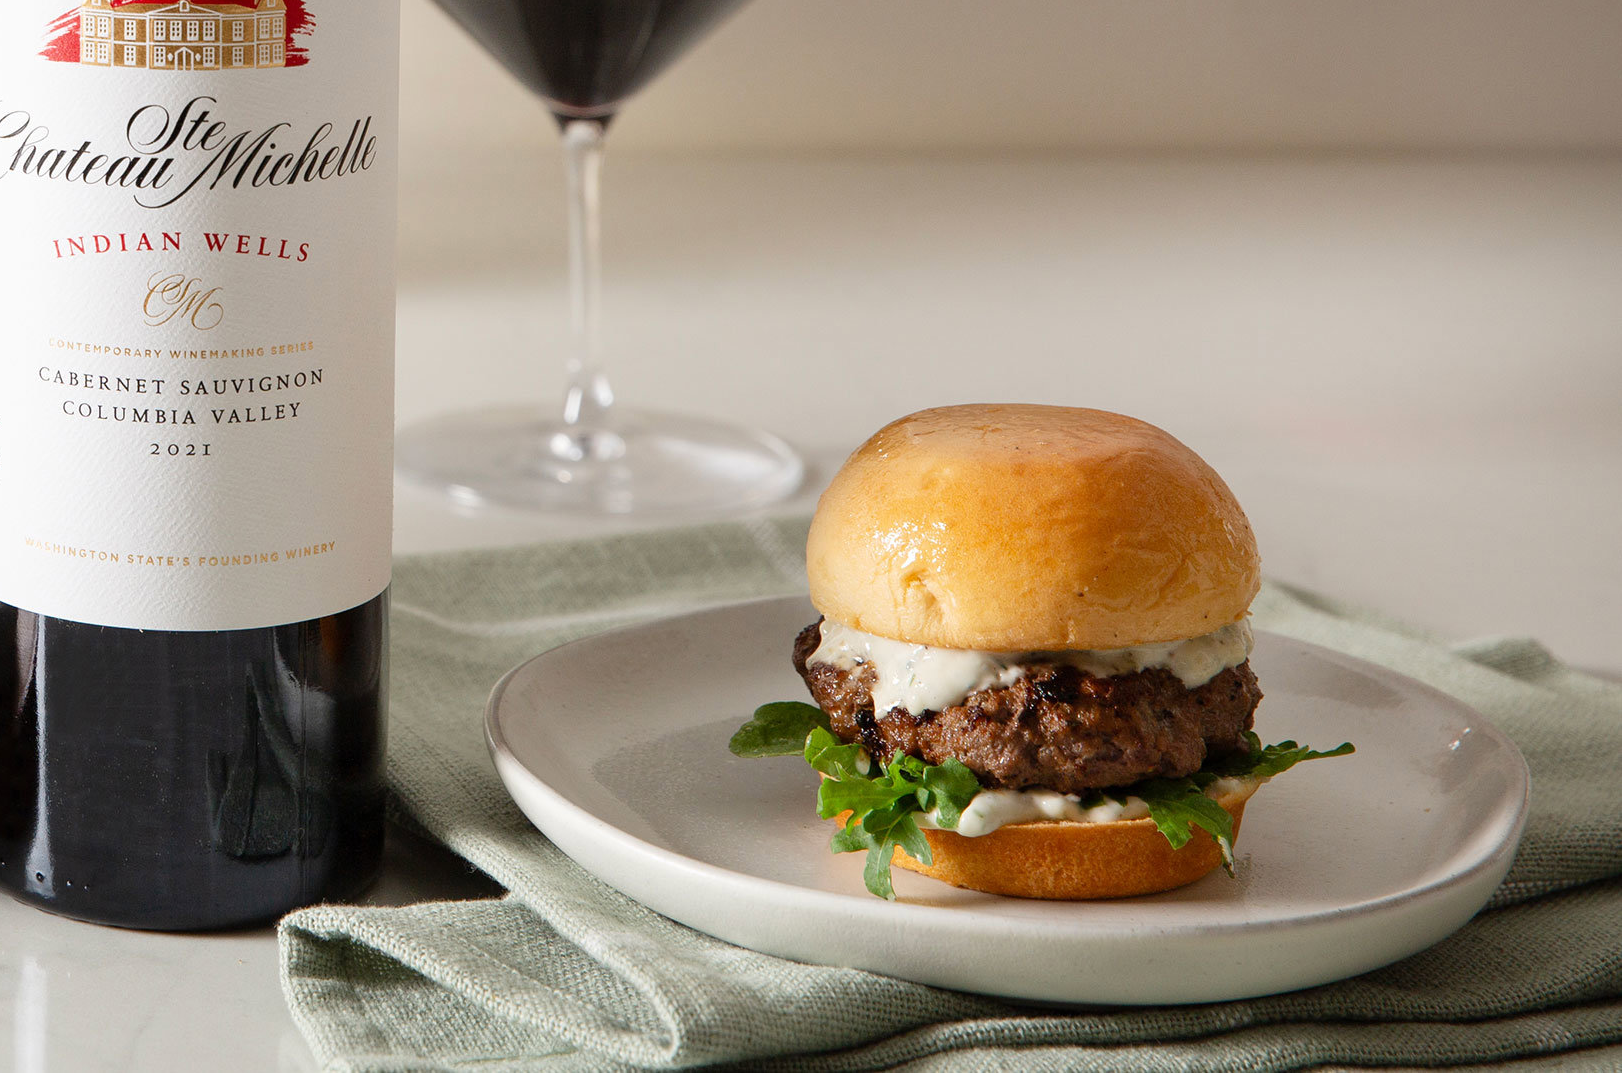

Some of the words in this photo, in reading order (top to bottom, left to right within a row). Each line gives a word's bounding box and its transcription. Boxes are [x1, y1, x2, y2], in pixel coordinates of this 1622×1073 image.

[125, 95, 227, 156] Ste
[133, 115, 377, 210] Michelle
[52, 230, 182, 259] INDIAN
[202, 231, 311, 263] WELLS
[48, 337, 162, 359] CONTEMPORARY
[169, 347, 265, 360] WINEMAKING
[270, 341, 314, 356] SERIES
[38, 366, 166, 395] CABERNET
[179, 368, 324, 396] SAUVIGNON
[62, 400, 197, 425] COLUMBIA
[210, 401, 301, 424] VALLEY
[149, 442, 212, 457] 2021
[24, 536, 120, 563] WASHINGTON
[127, 553, 191, 567] STATE'S
[198, 551, 279, 567] FOUNDING
[285, 541, 336, 560] WINERY
